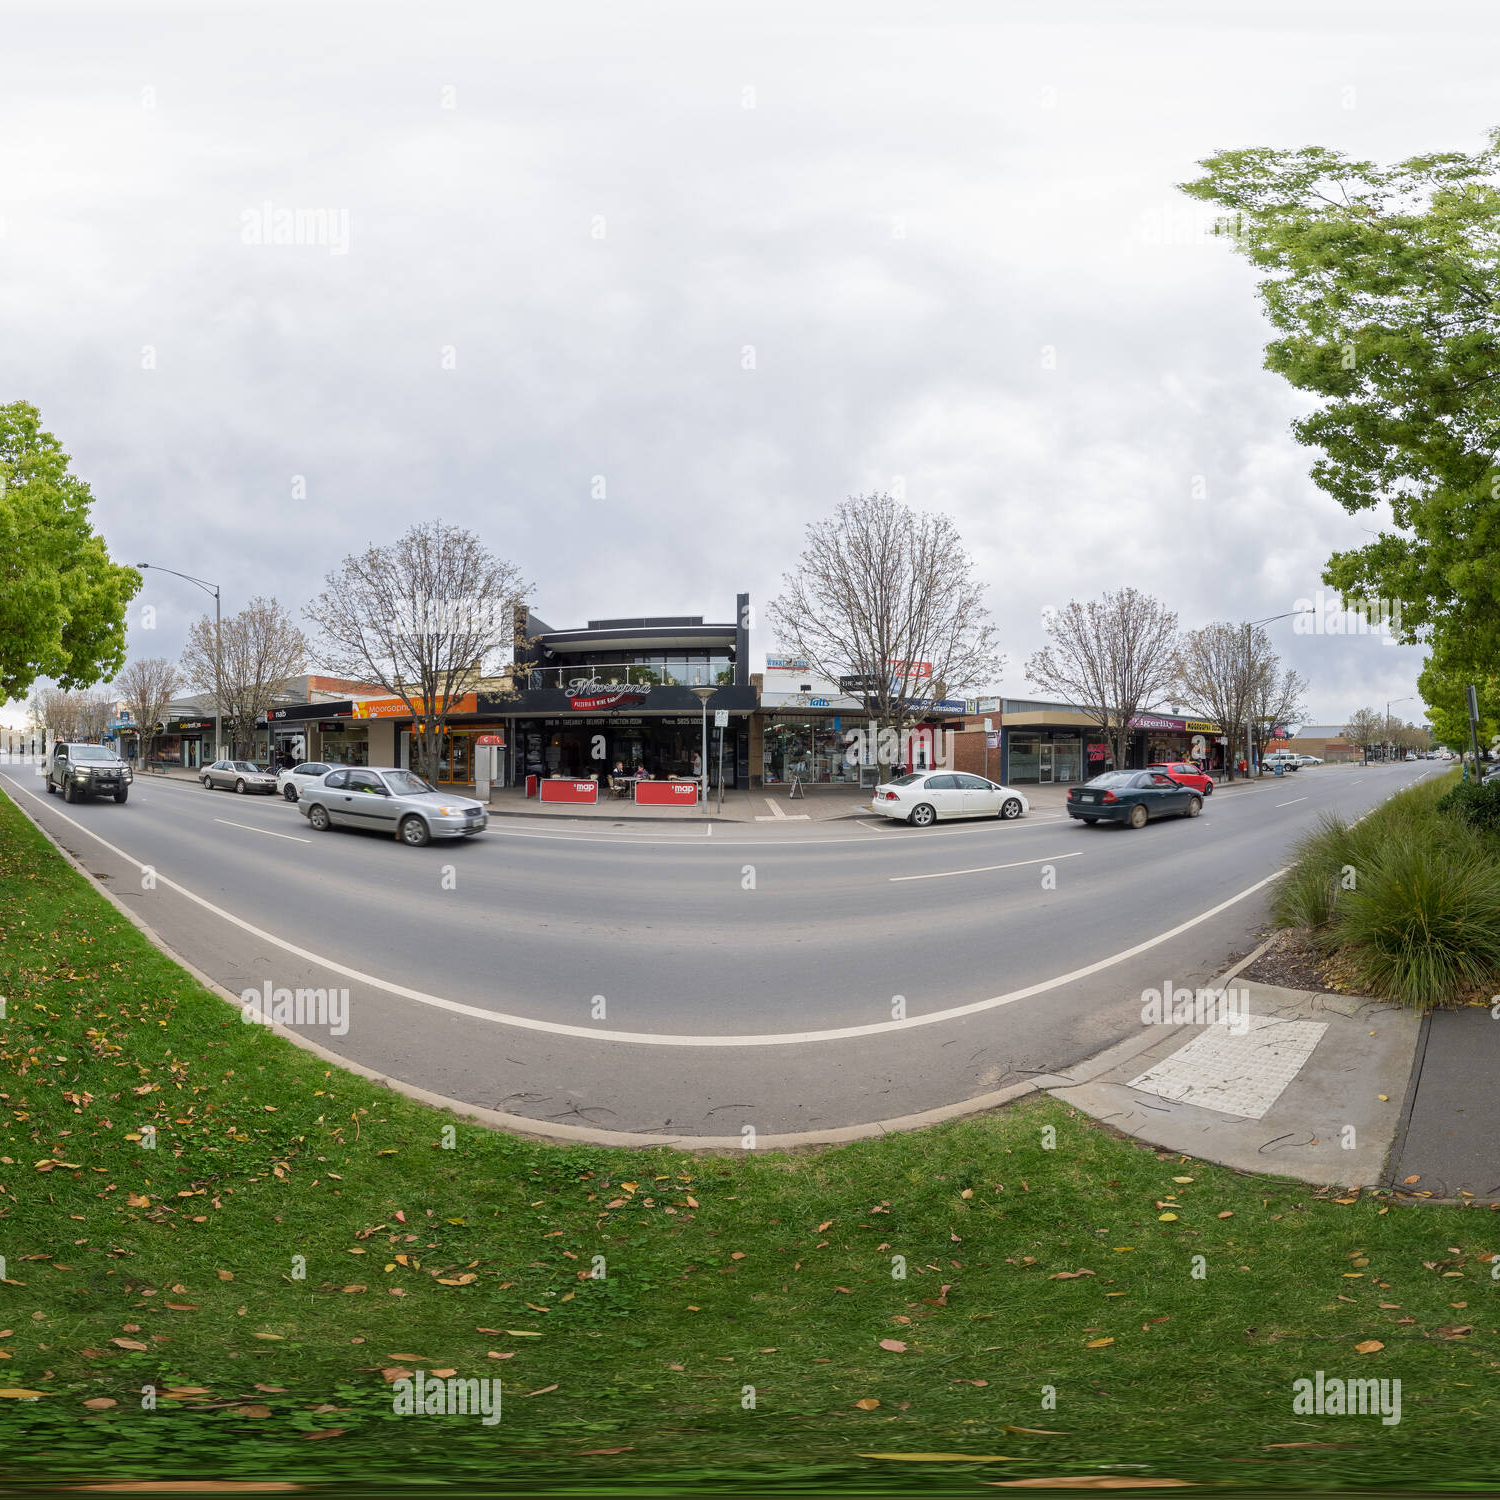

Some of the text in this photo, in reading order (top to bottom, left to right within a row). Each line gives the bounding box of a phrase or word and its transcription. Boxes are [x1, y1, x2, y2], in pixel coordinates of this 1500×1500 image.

[275, 709, 287, 718] nab
[576, 783, 595, 792] map
[674, 784, 694, 793] map
